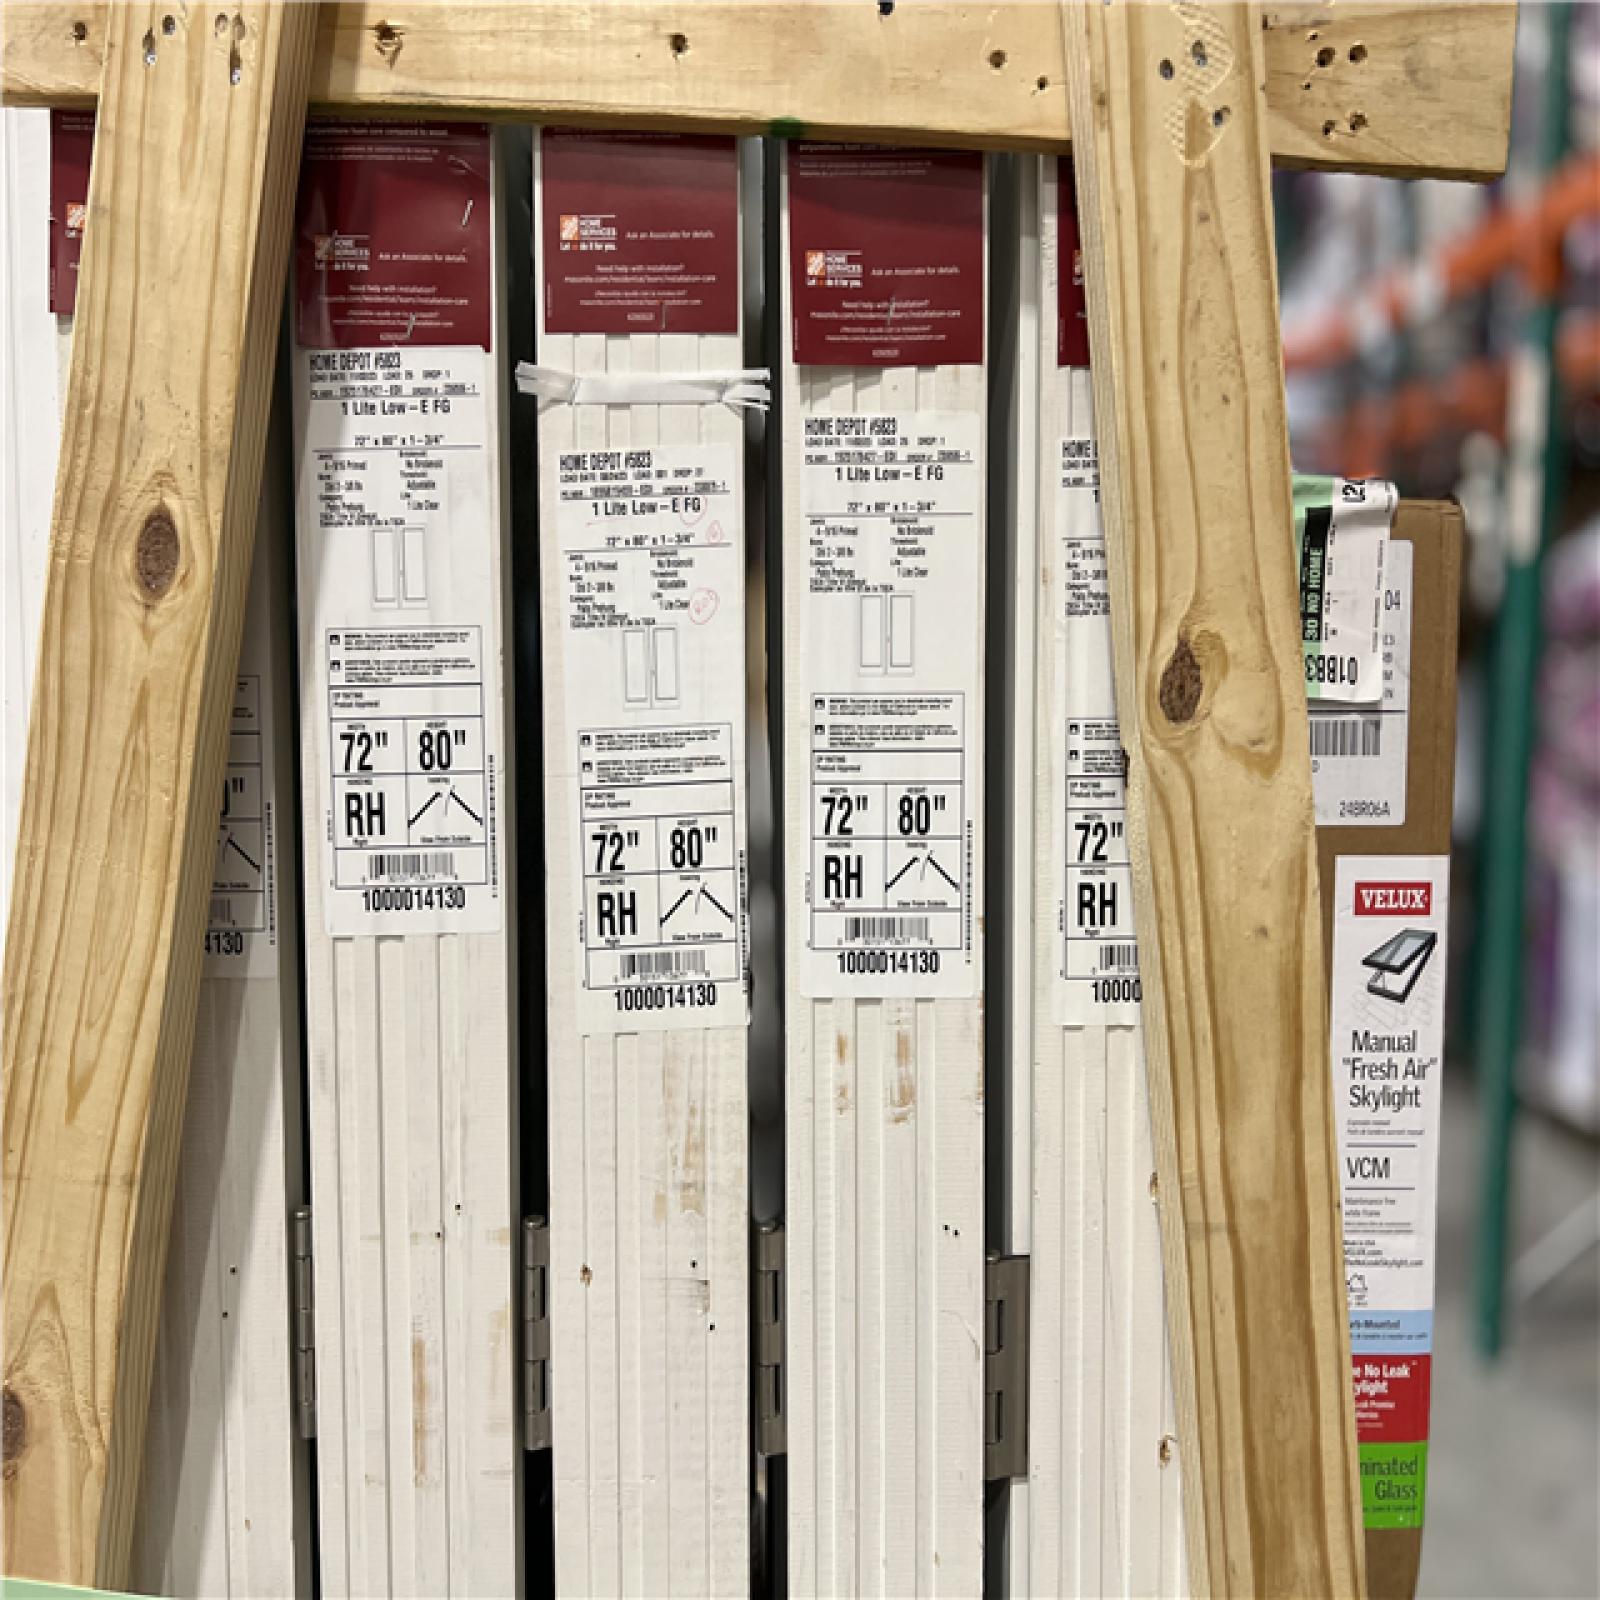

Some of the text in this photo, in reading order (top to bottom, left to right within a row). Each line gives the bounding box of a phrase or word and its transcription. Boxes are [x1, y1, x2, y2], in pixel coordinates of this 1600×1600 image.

[310, 354, 339, 371] HOME
[340, 352, 371, 371] DEPOT
[352, 401, 376, 416] Lite
[432, 398, 451, 413] FG
[805, 417, 833, 435] HOME
[835, 417, 867, 435] DEPOT
[560, 453, 588, 470] HOME
[589, 452, 621, 470] DEPOT
[1062, 440, 1091, 458] HOME
[847, 466, 871, 481] Lite
[927, 464, 944, 481] FG
[604, 501, 627, 516] Lite
[1308, 546, 1324, 589] HOME
[339, 729, 466, 773] 72" 80"
[344, 791, 386, 836] RH
[820, 795, 946, 836] 72" 80"
[591, 827, 718, 873] 72" 80"
[1074, 821, 1124, 863] 72"
[824, 854, 863, 898] RH
[362, 885, 466, 912] 1000014130
[1077, 881, 1118, 927] RH
[597, 890, 637, 936] RH
[837, 949, 941, 974] 1000014130
[614, 982, 717, 1011] 1000014130
[1351, 1029, 1418, 1053] Manual
[1349, 1084, 1421, 1113] Skylight
[1346, 1156, 1391, 1179] VCM
[1364, 1362, 1380, 1378] No
[1354, 1380, 1389, 1397] ylight
[1374, 1479, 1418, 1501] Glass
